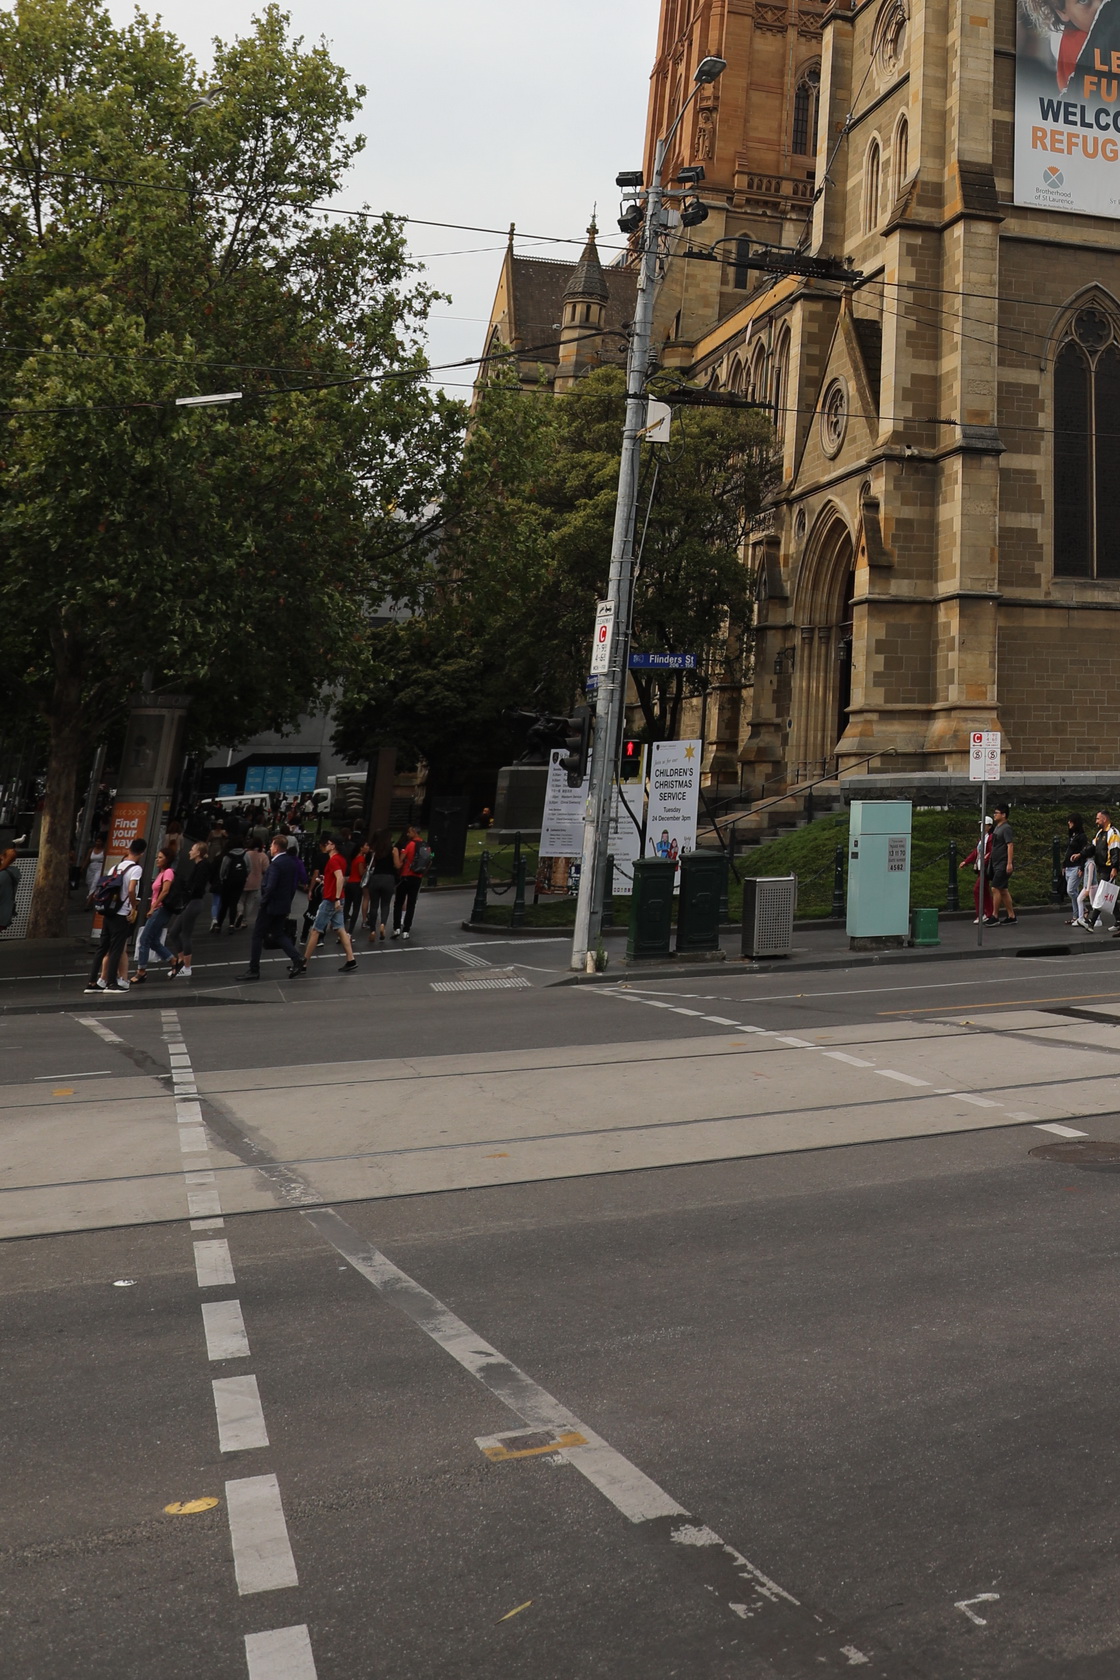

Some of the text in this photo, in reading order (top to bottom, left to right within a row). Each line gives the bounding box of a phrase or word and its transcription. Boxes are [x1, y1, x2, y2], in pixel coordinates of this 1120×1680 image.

[1035, 187, 1071, 198] Brotherhood
[1049, 196, 1074, 205] Laurence
[649, 654, 695, 664] Flinders St
[655, 767, 694, 777] CHILDREN'S
[654, 779, 693, 789] CHRISTMAS
[659, 792, 687, 801] SERVICE
[663, 806, 681, 814] Tuesday
[114, 818, 139, 828] Find
[112, 829, 138, 839] your
[112, 839, 134, 849] way
